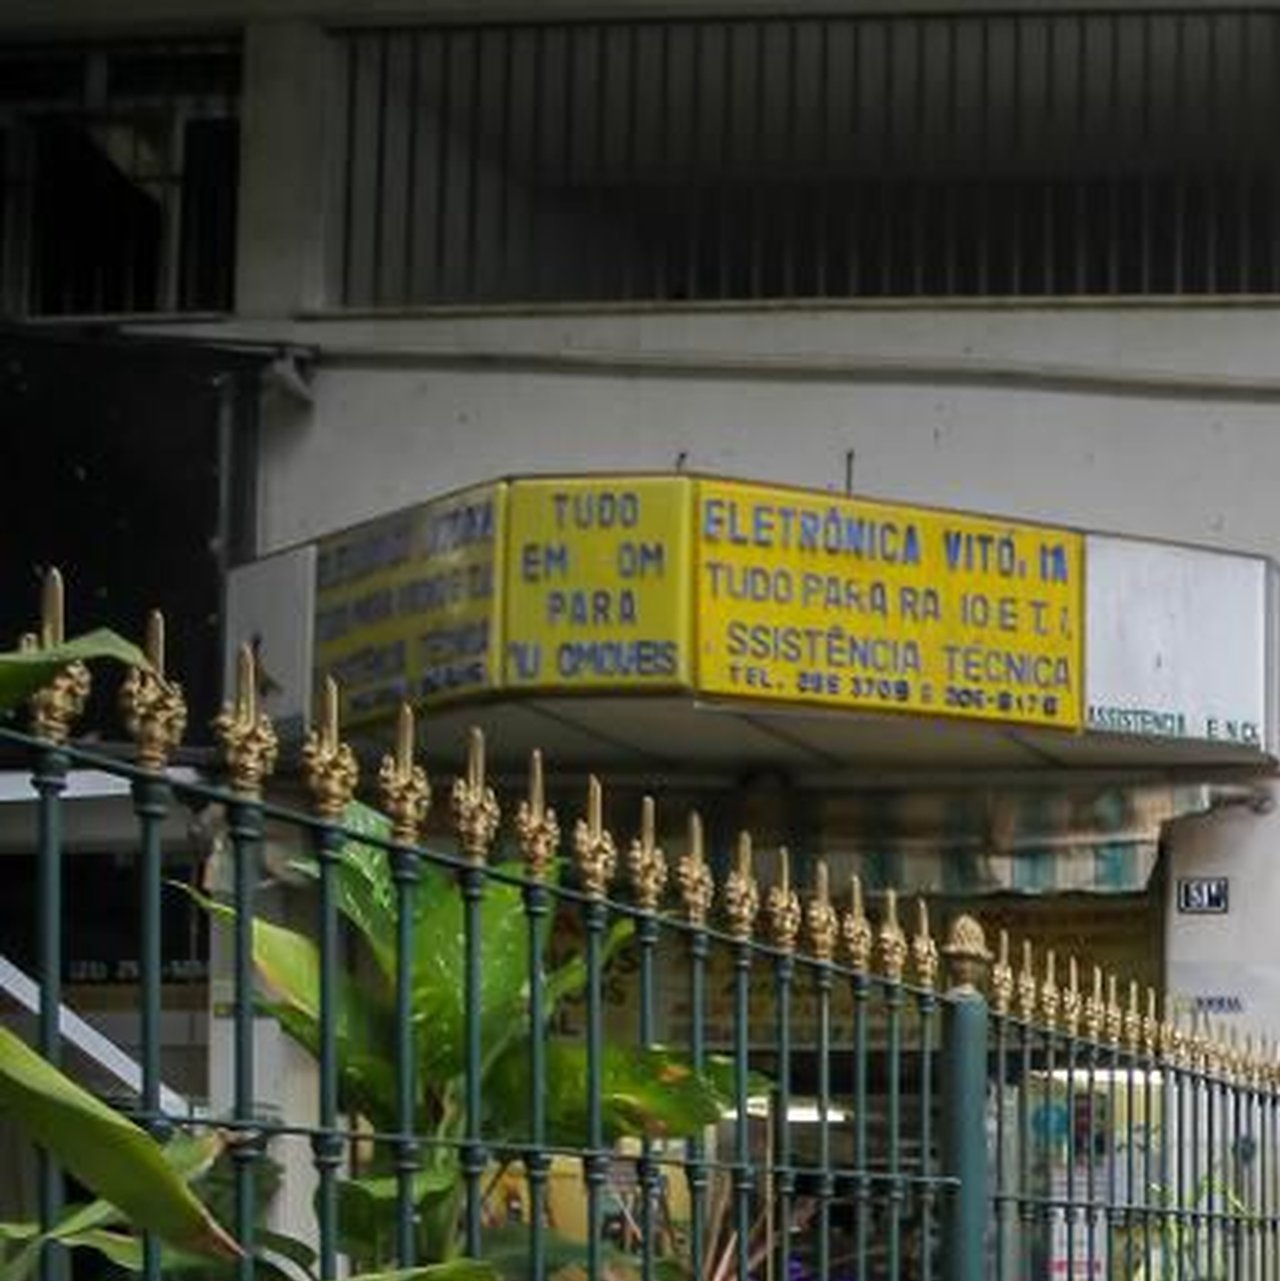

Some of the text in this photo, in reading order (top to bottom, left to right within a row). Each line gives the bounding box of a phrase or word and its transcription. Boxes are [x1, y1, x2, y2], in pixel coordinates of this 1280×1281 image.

[553, 491, 640, 530] TUDO
[704, 499, 921, 567] ELETRÔNICA
[522, 543, 568, 582] EM
[548, 589, 636, 628] PARA
[705, 560, 794, 604] TUDO
[802, 573, 887, 619] PARA
